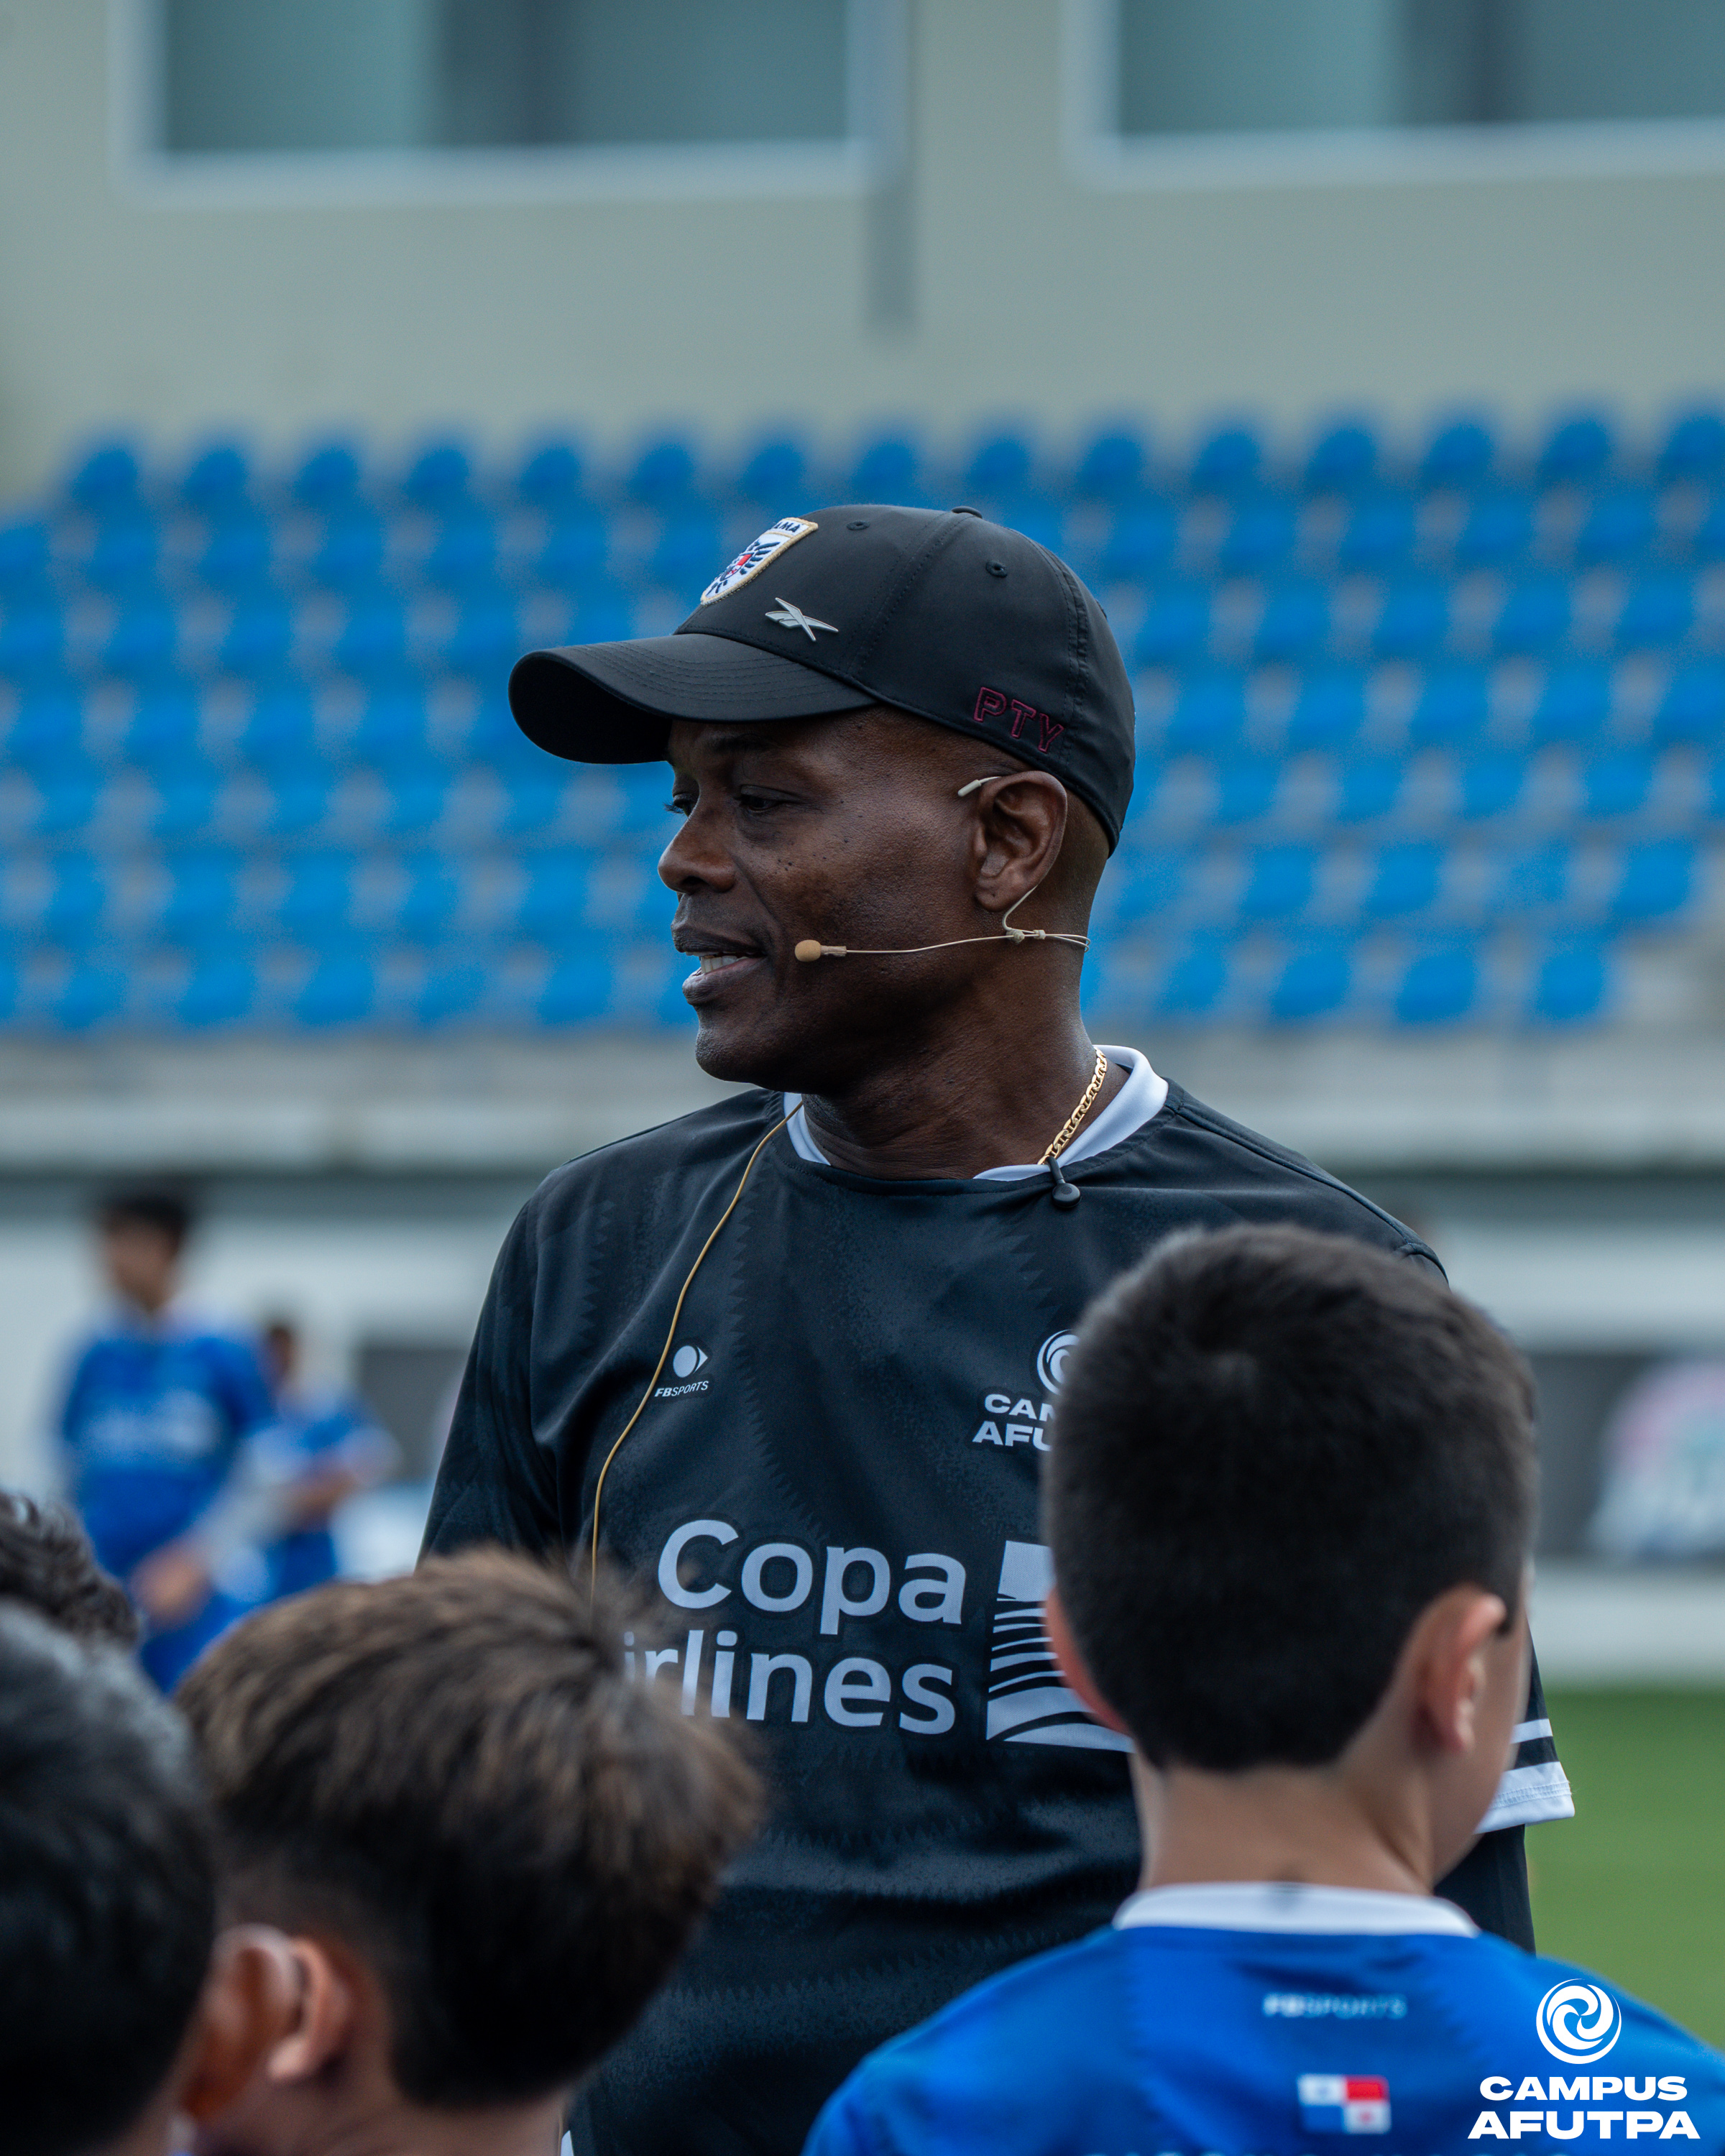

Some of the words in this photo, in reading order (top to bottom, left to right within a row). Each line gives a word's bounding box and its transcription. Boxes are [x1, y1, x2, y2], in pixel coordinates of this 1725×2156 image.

[973, 686, 1064, 753] PTY
[654, 1381, 709, 1397] FBSPORTS
[658, 1519, 967, 1635] Copa
